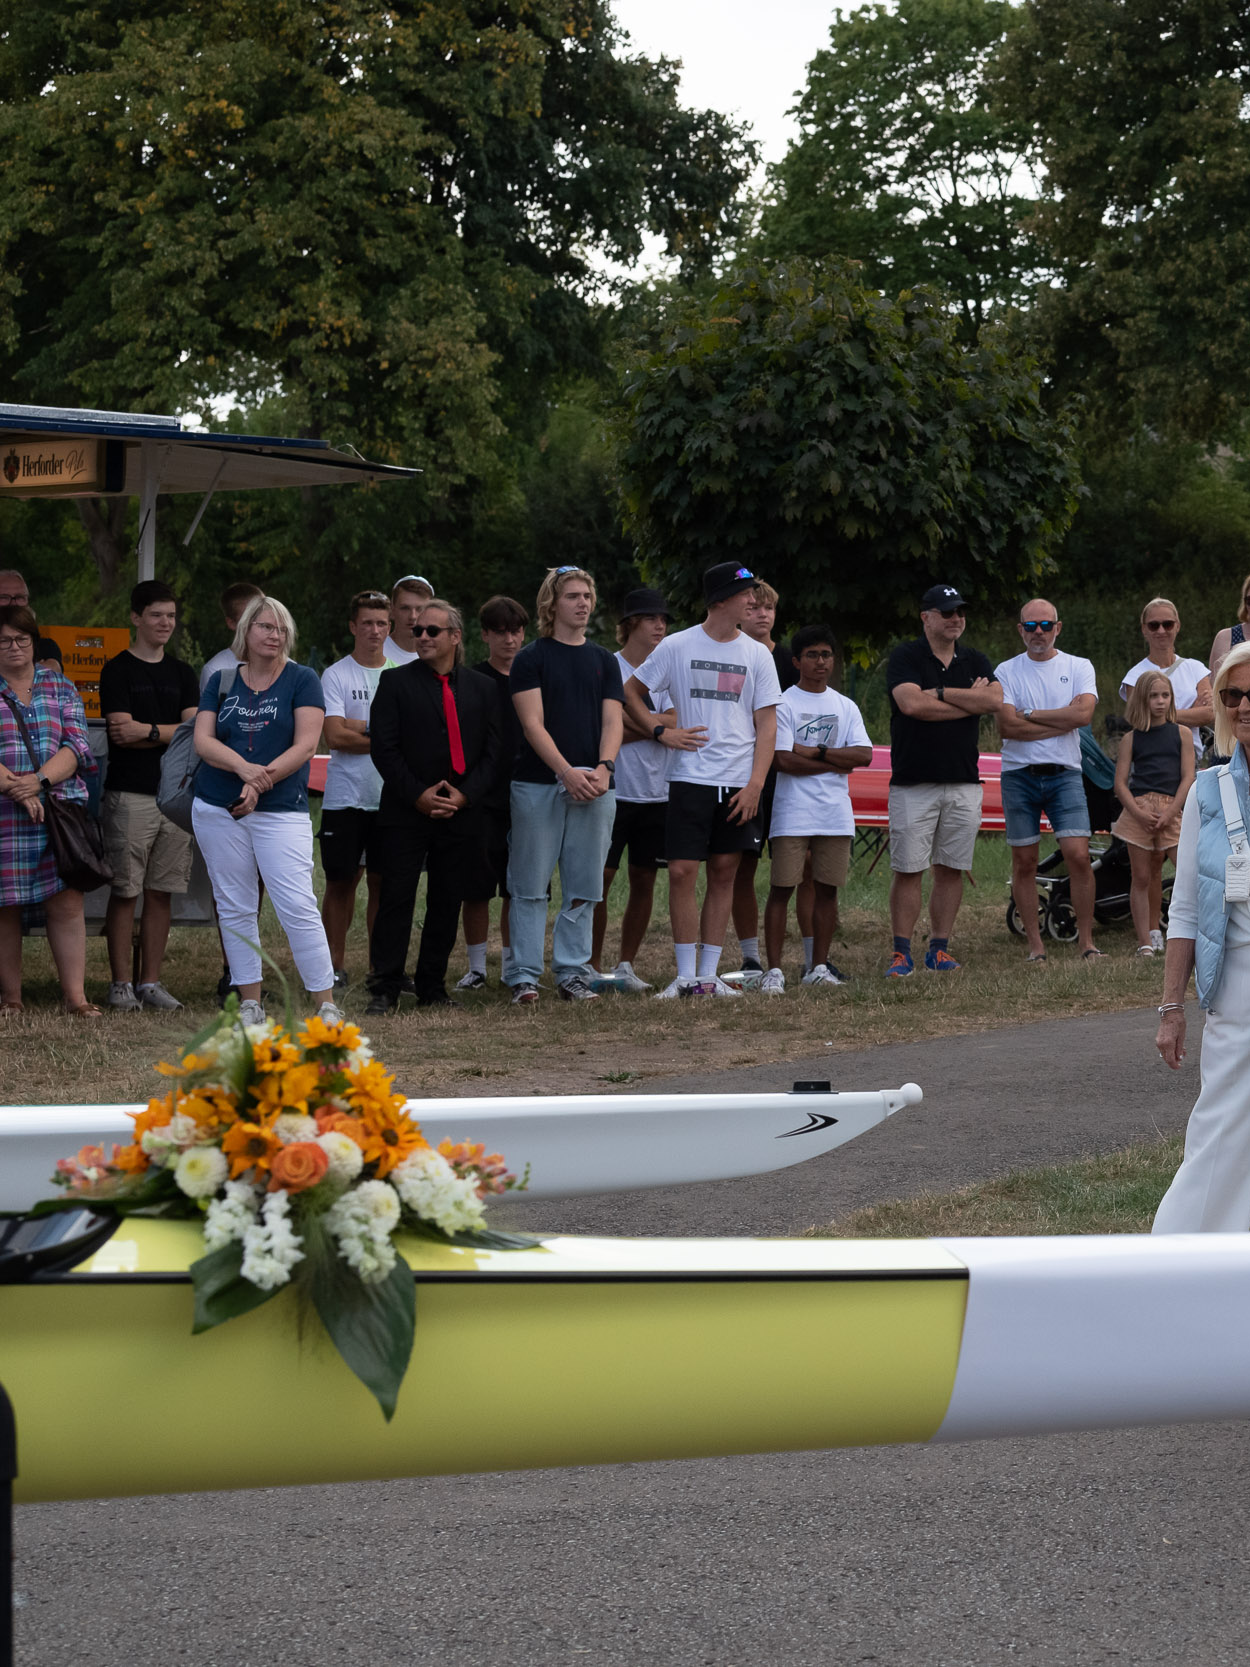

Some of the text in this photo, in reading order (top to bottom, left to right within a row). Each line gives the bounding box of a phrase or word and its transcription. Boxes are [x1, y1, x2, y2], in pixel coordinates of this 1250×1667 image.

[22, 448, 86, 477] Herforder Pils
[72, 653, 108, 666] Herford
[694, 661, 745, 673] TOMMY
[693, 690, 739, 701] JEANS
[218, 695, 278, 722] Journey
[797, 713, 836, 743] Tommy
